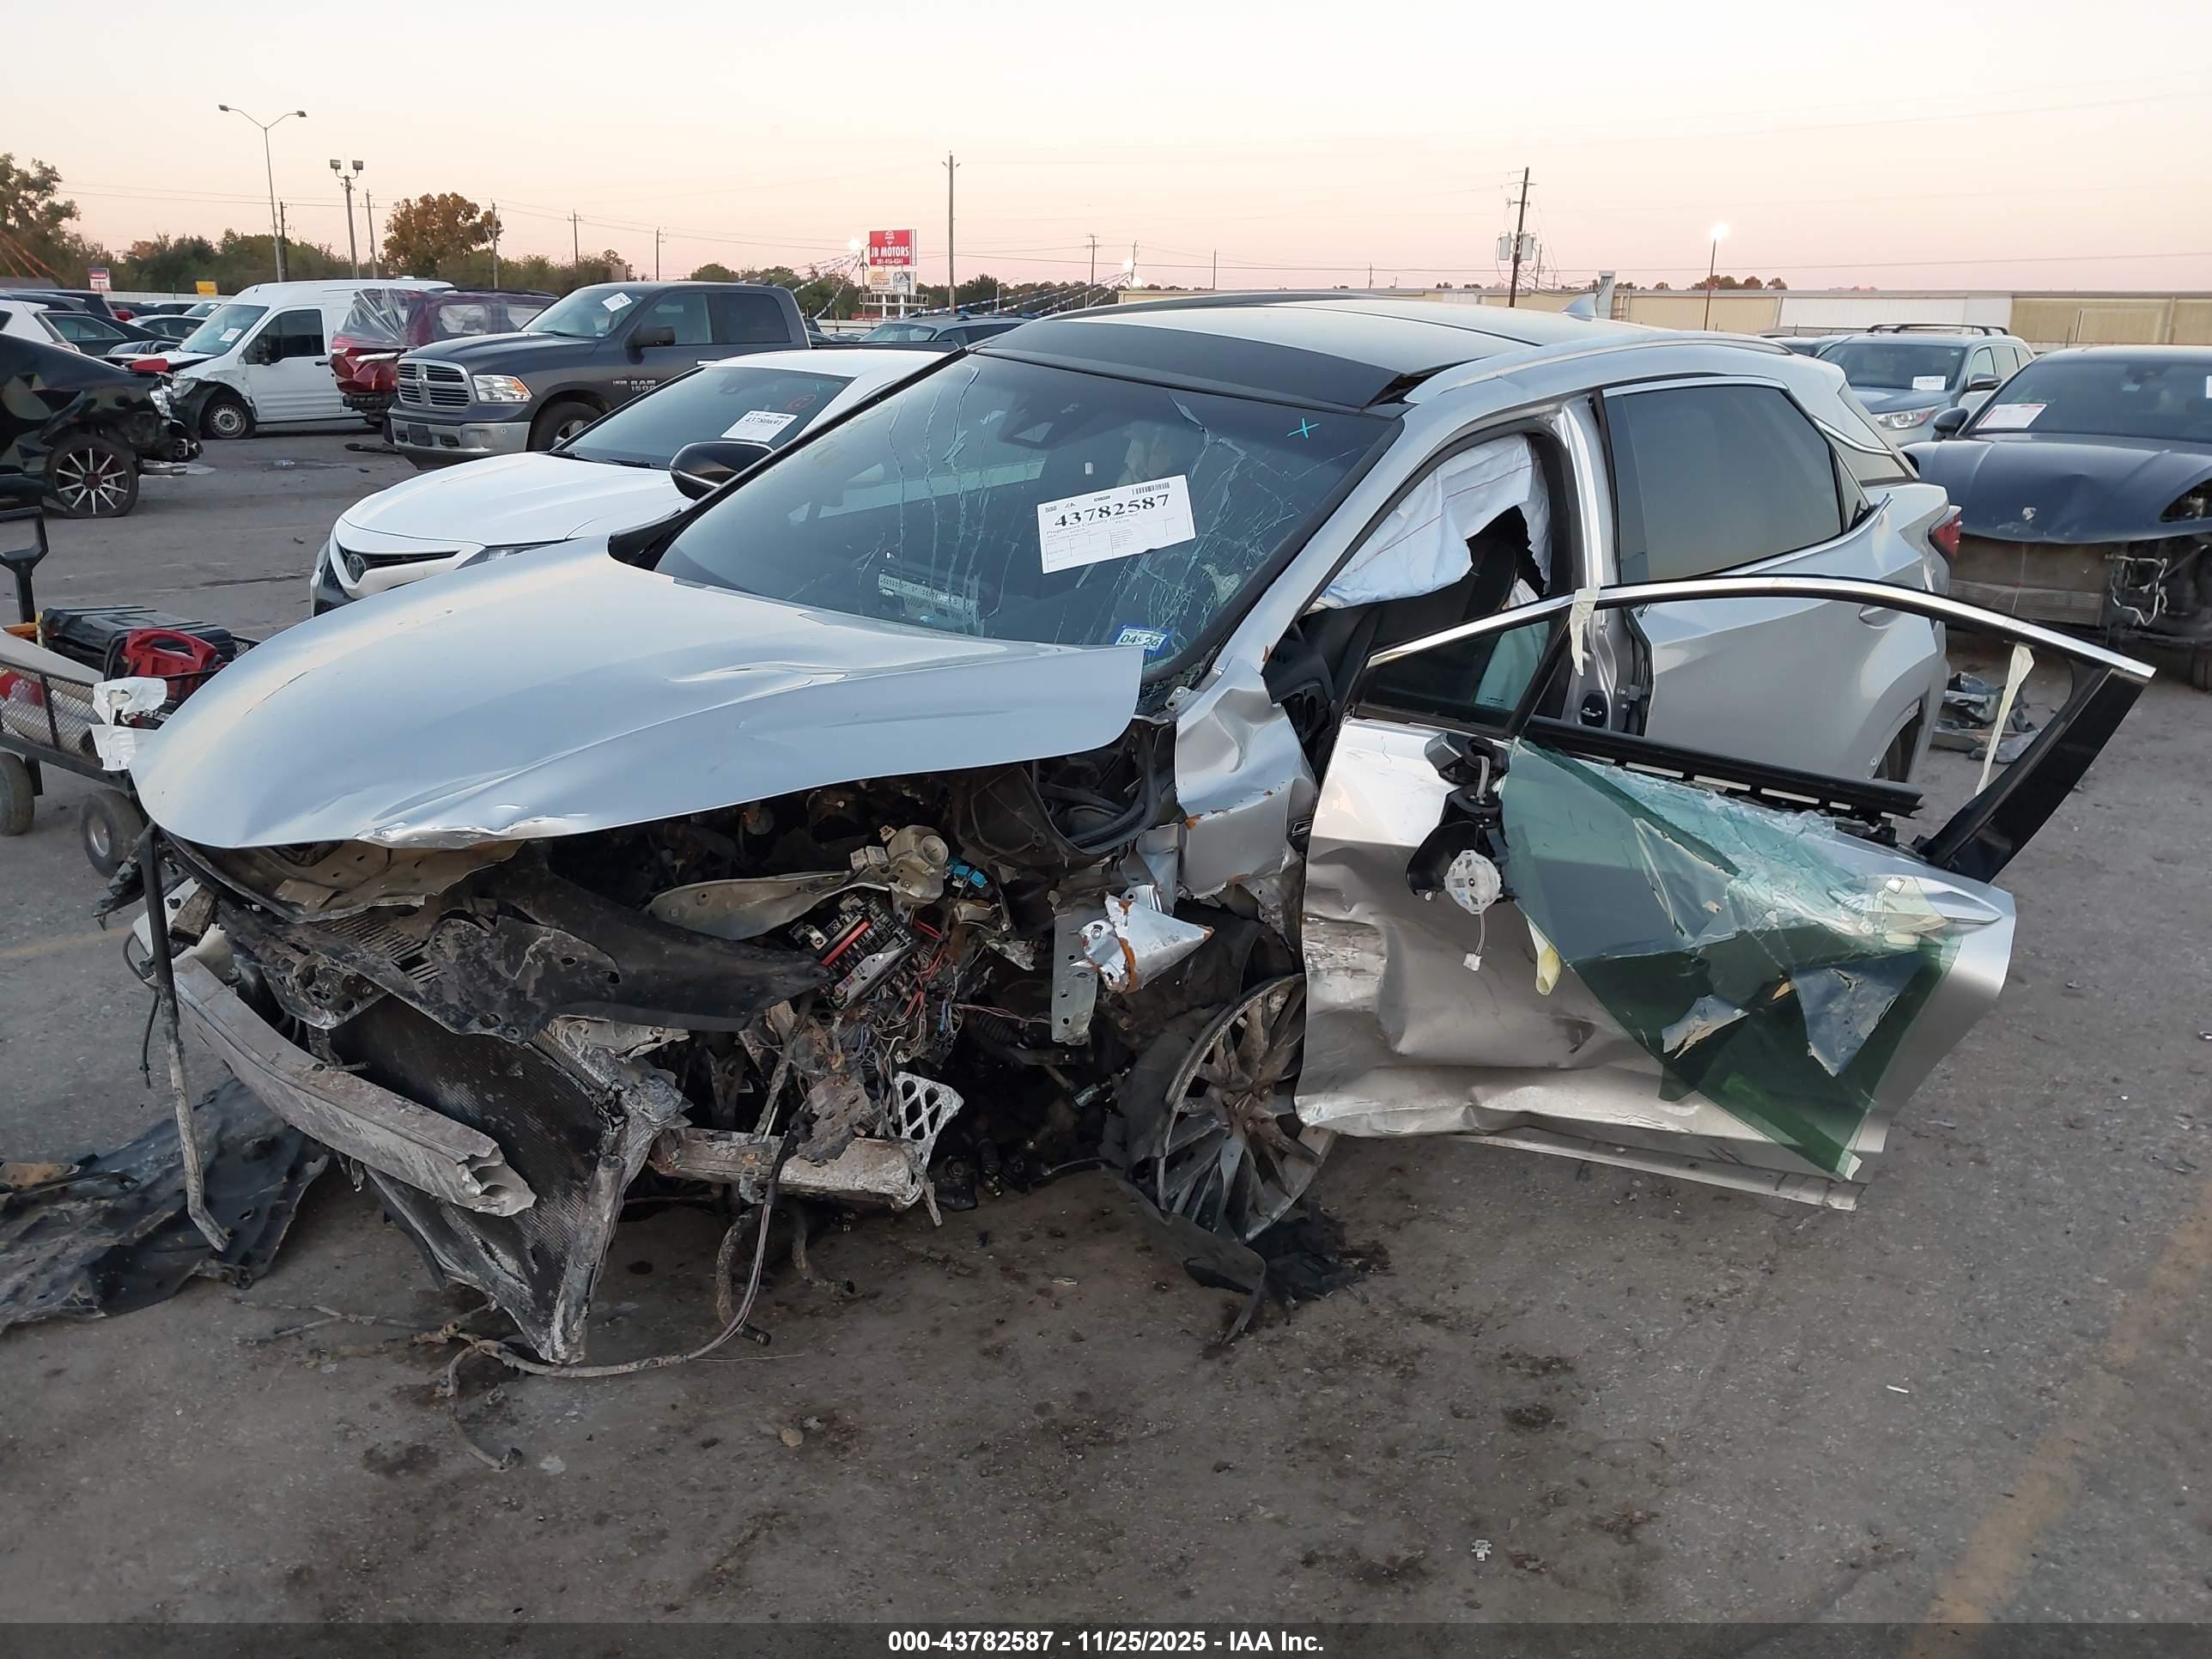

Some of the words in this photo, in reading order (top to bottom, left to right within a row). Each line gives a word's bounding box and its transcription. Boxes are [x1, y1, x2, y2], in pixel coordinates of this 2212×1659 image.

[871, 246, 879, 258] JB
[880, 246, 909, 258] MOTORS
[1054, 494, 1170, 527] 43782587
